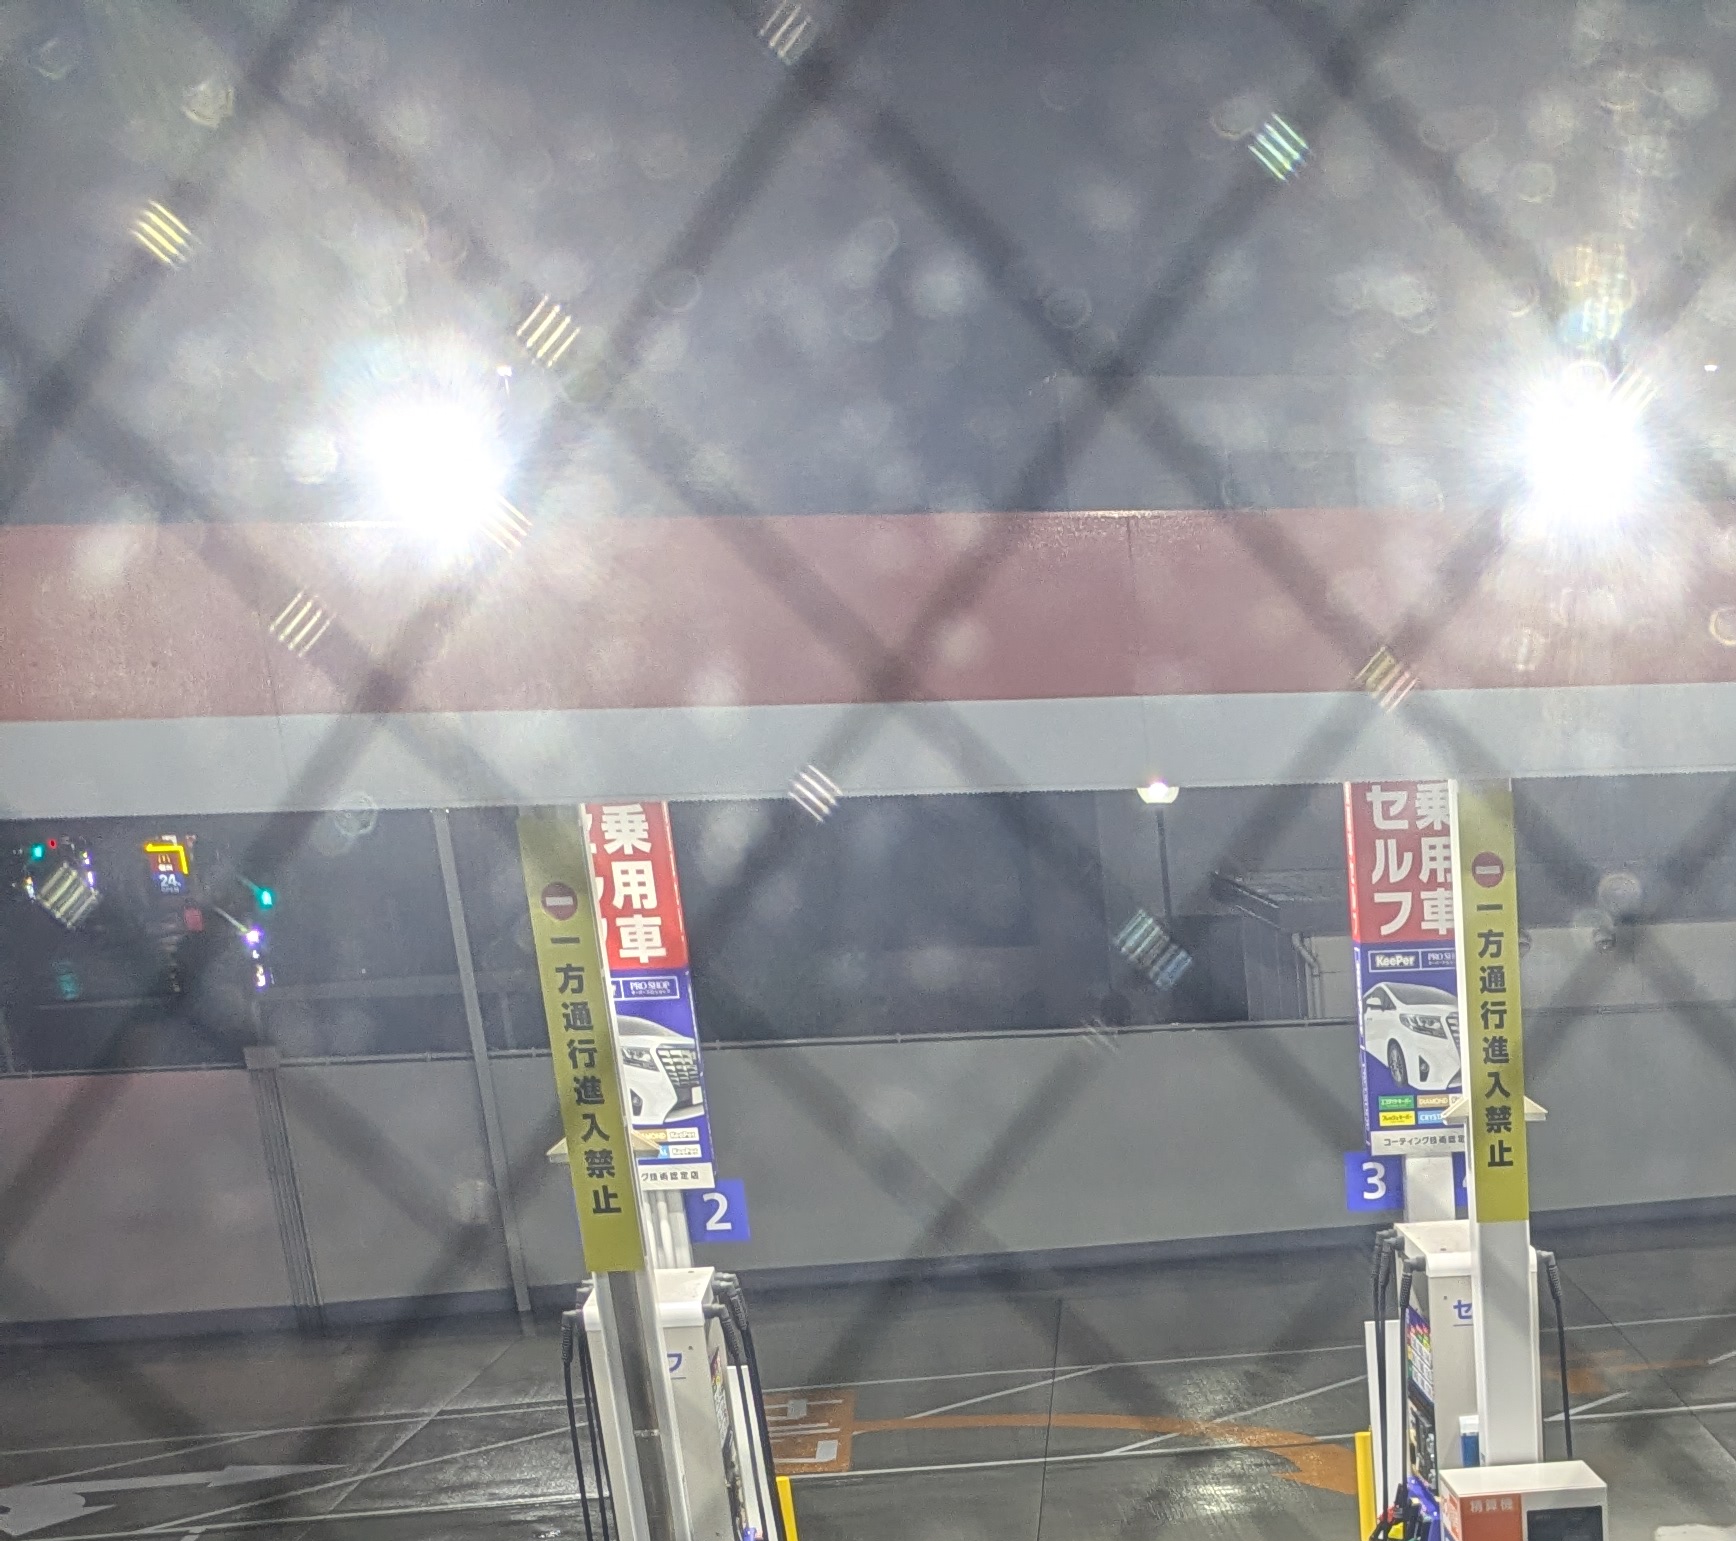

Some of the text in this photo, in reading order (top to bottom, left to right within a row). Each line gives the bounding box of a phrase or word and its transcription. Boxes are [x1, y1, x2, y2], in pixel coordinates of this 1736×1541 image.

[1365, 784, 1413, 936] セルフ
[1415, 782, 1456, 935] 乗用車
[600, 803, 667, 964] 乗用車
[1375, 954, 1416, 968] KeePer
[629, 981, 671, 991] PRO SHOP
[1476, 903, 1514, 1168] 一方通行進入禁止
[550, 936, 622, 1215] 一方通行進入禁止
[1419, 1097, 1448, 1105] DIAMOND
[1420, 1113, 1443, 1121] CRYST
[1384, 1135, 1465, 1147] コーティング技術認定
[1362, 1161, 1387, 1200] 3
[703, 1192, 733, 1231] 2
[1470, 1498, 1514, 1514] 精算機
